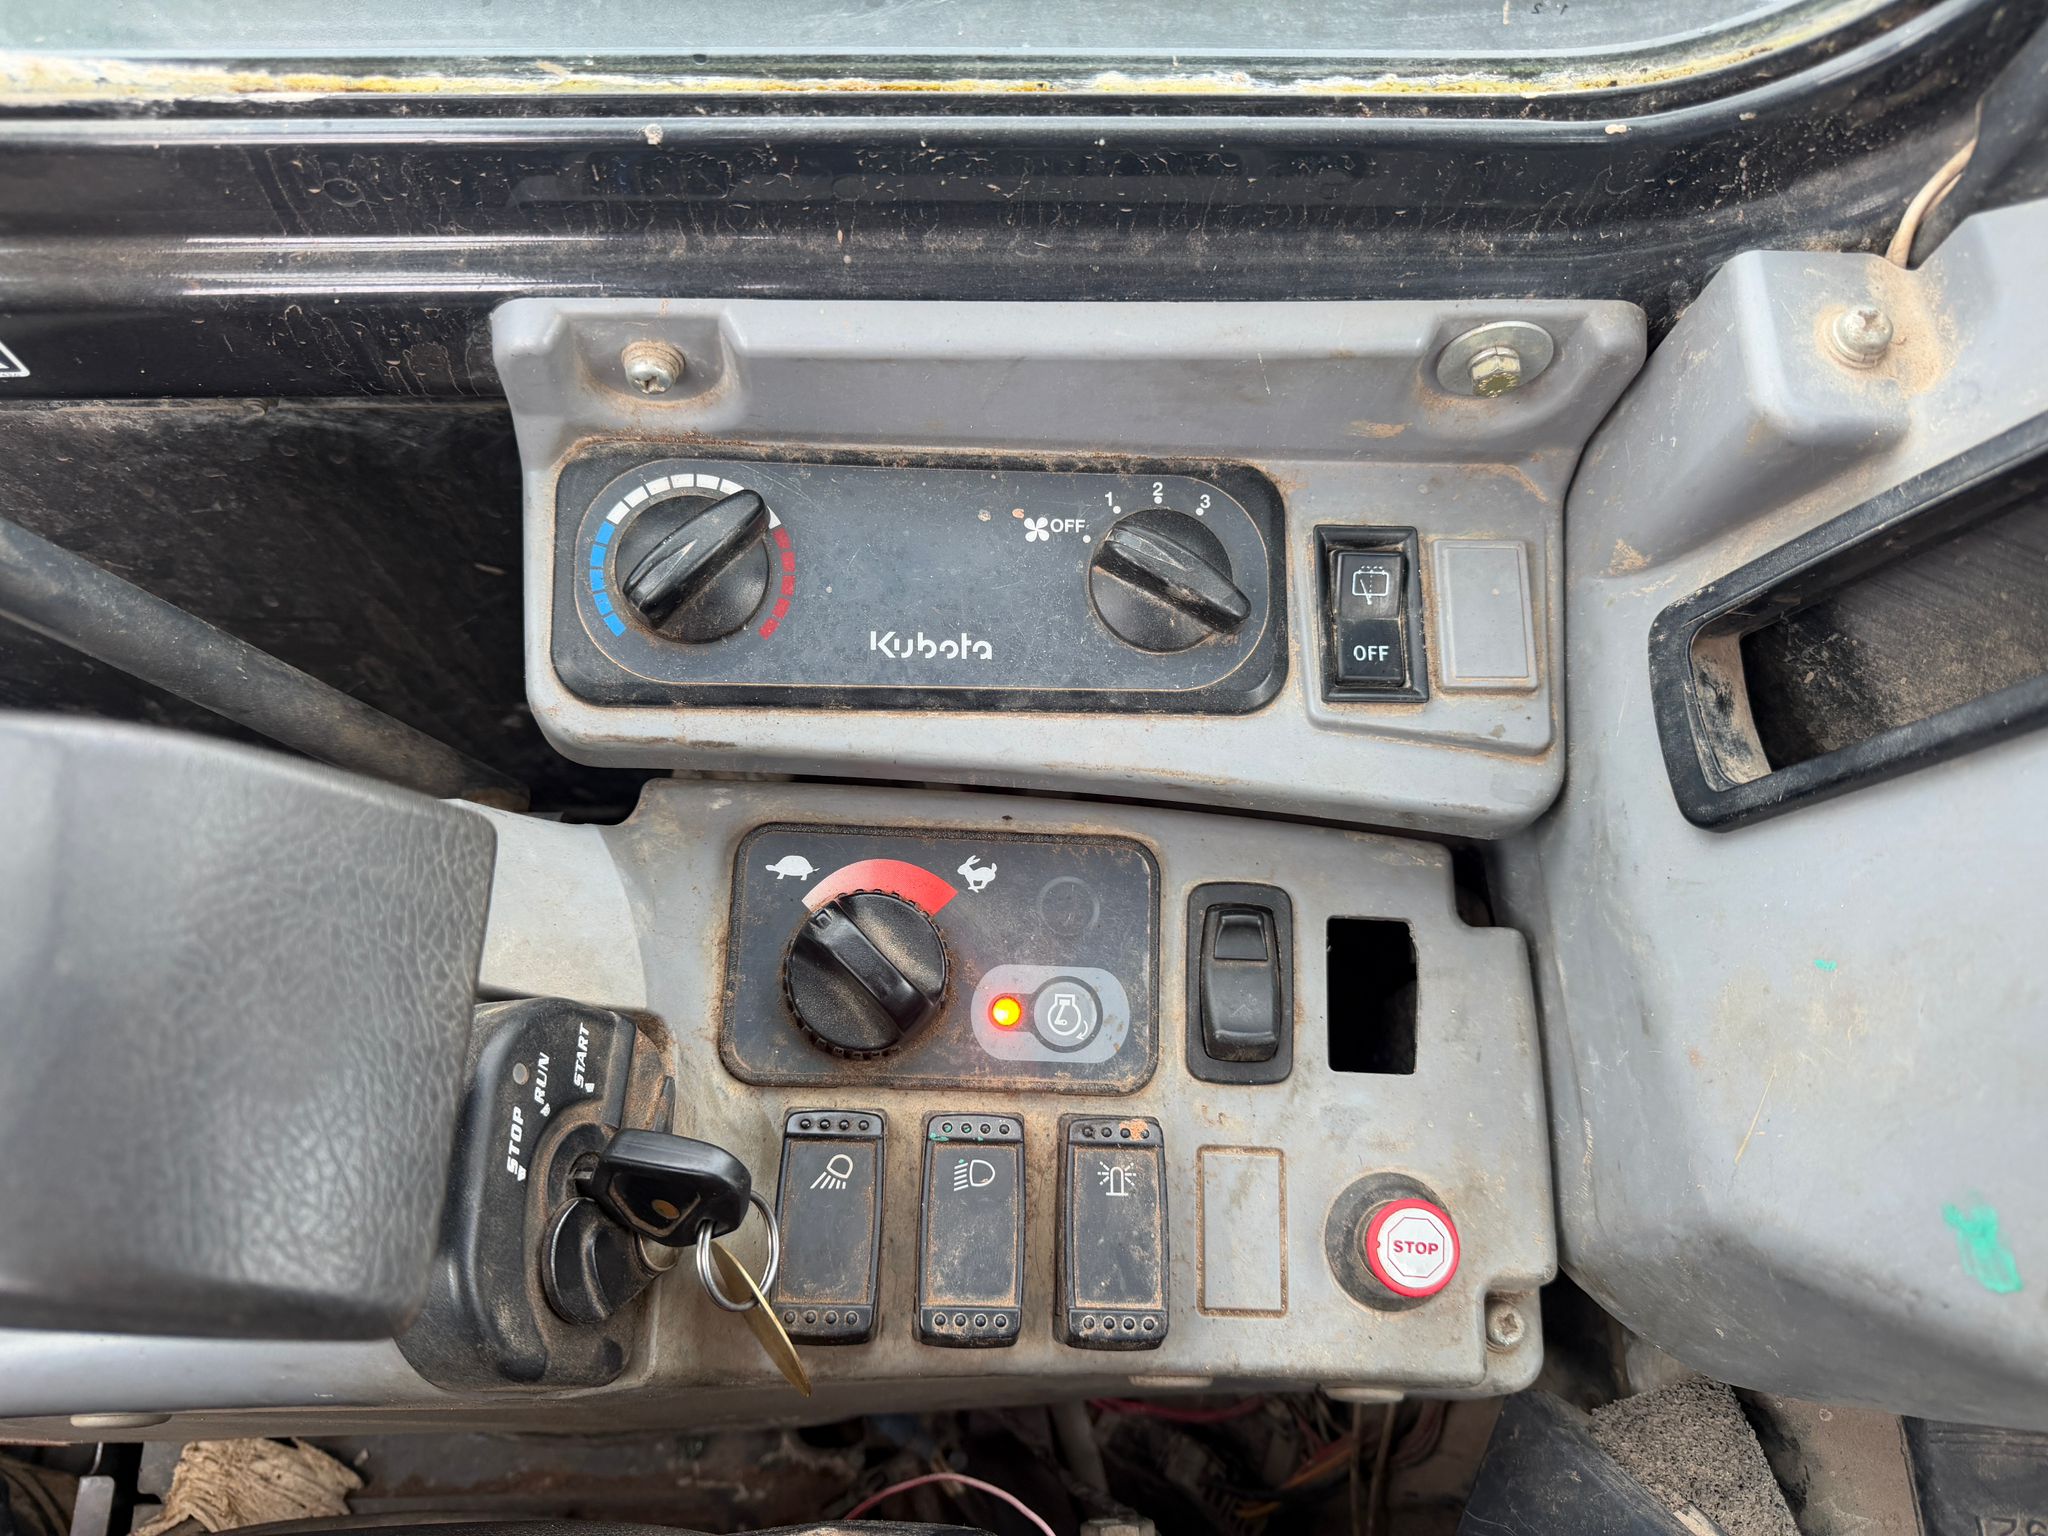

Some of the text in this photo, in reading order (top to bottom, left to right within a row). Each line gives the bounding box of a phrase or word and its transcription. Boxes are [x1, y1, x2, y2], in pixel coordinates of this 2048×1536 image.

[1153, 482, 1163, 496] 2
[1105, 492, 1113, 507] 1
[1200, 494, 1211, 509] 3
[1050, 518, 1086, 533] OFF
[870, 631, 993, 660] Kubota
[1353, 645, 1390, 661] OFF
[574, 1022, 590, 1088] START
[534, 1052, 550, 1105] RUN
[507, 1106, 524, 1175] STOP
[1393, 1240, 1439, 1255] STOP
